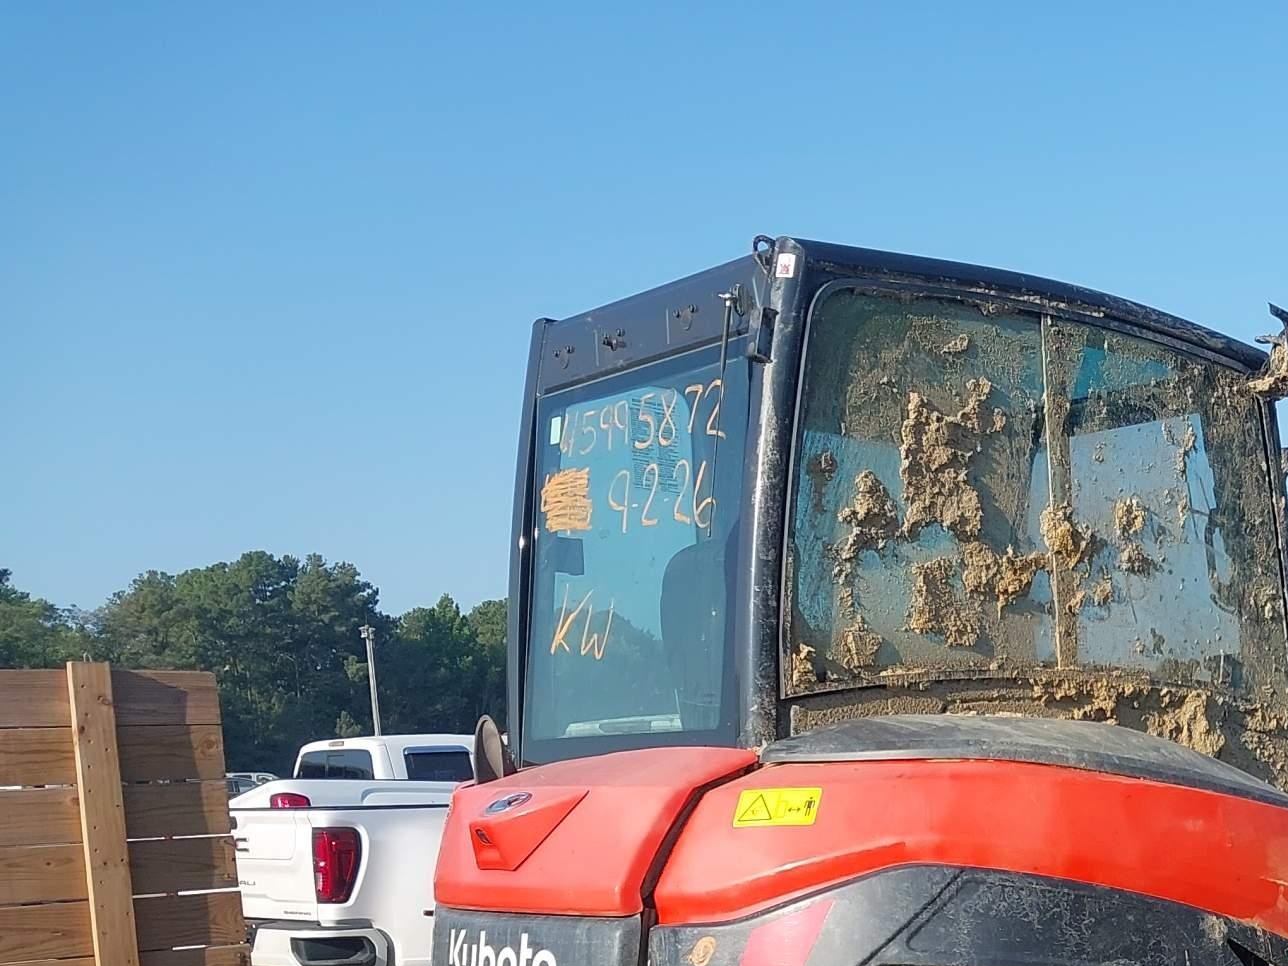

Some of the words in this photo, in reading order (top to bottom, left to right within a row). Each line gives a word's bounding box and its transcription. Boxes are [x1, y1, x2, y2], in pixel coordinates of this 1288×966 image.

[559, 378, 727, 458] 45995872
[608, 459, 717, 534] 9-2-26
[550, 583, 616, 660] KW
